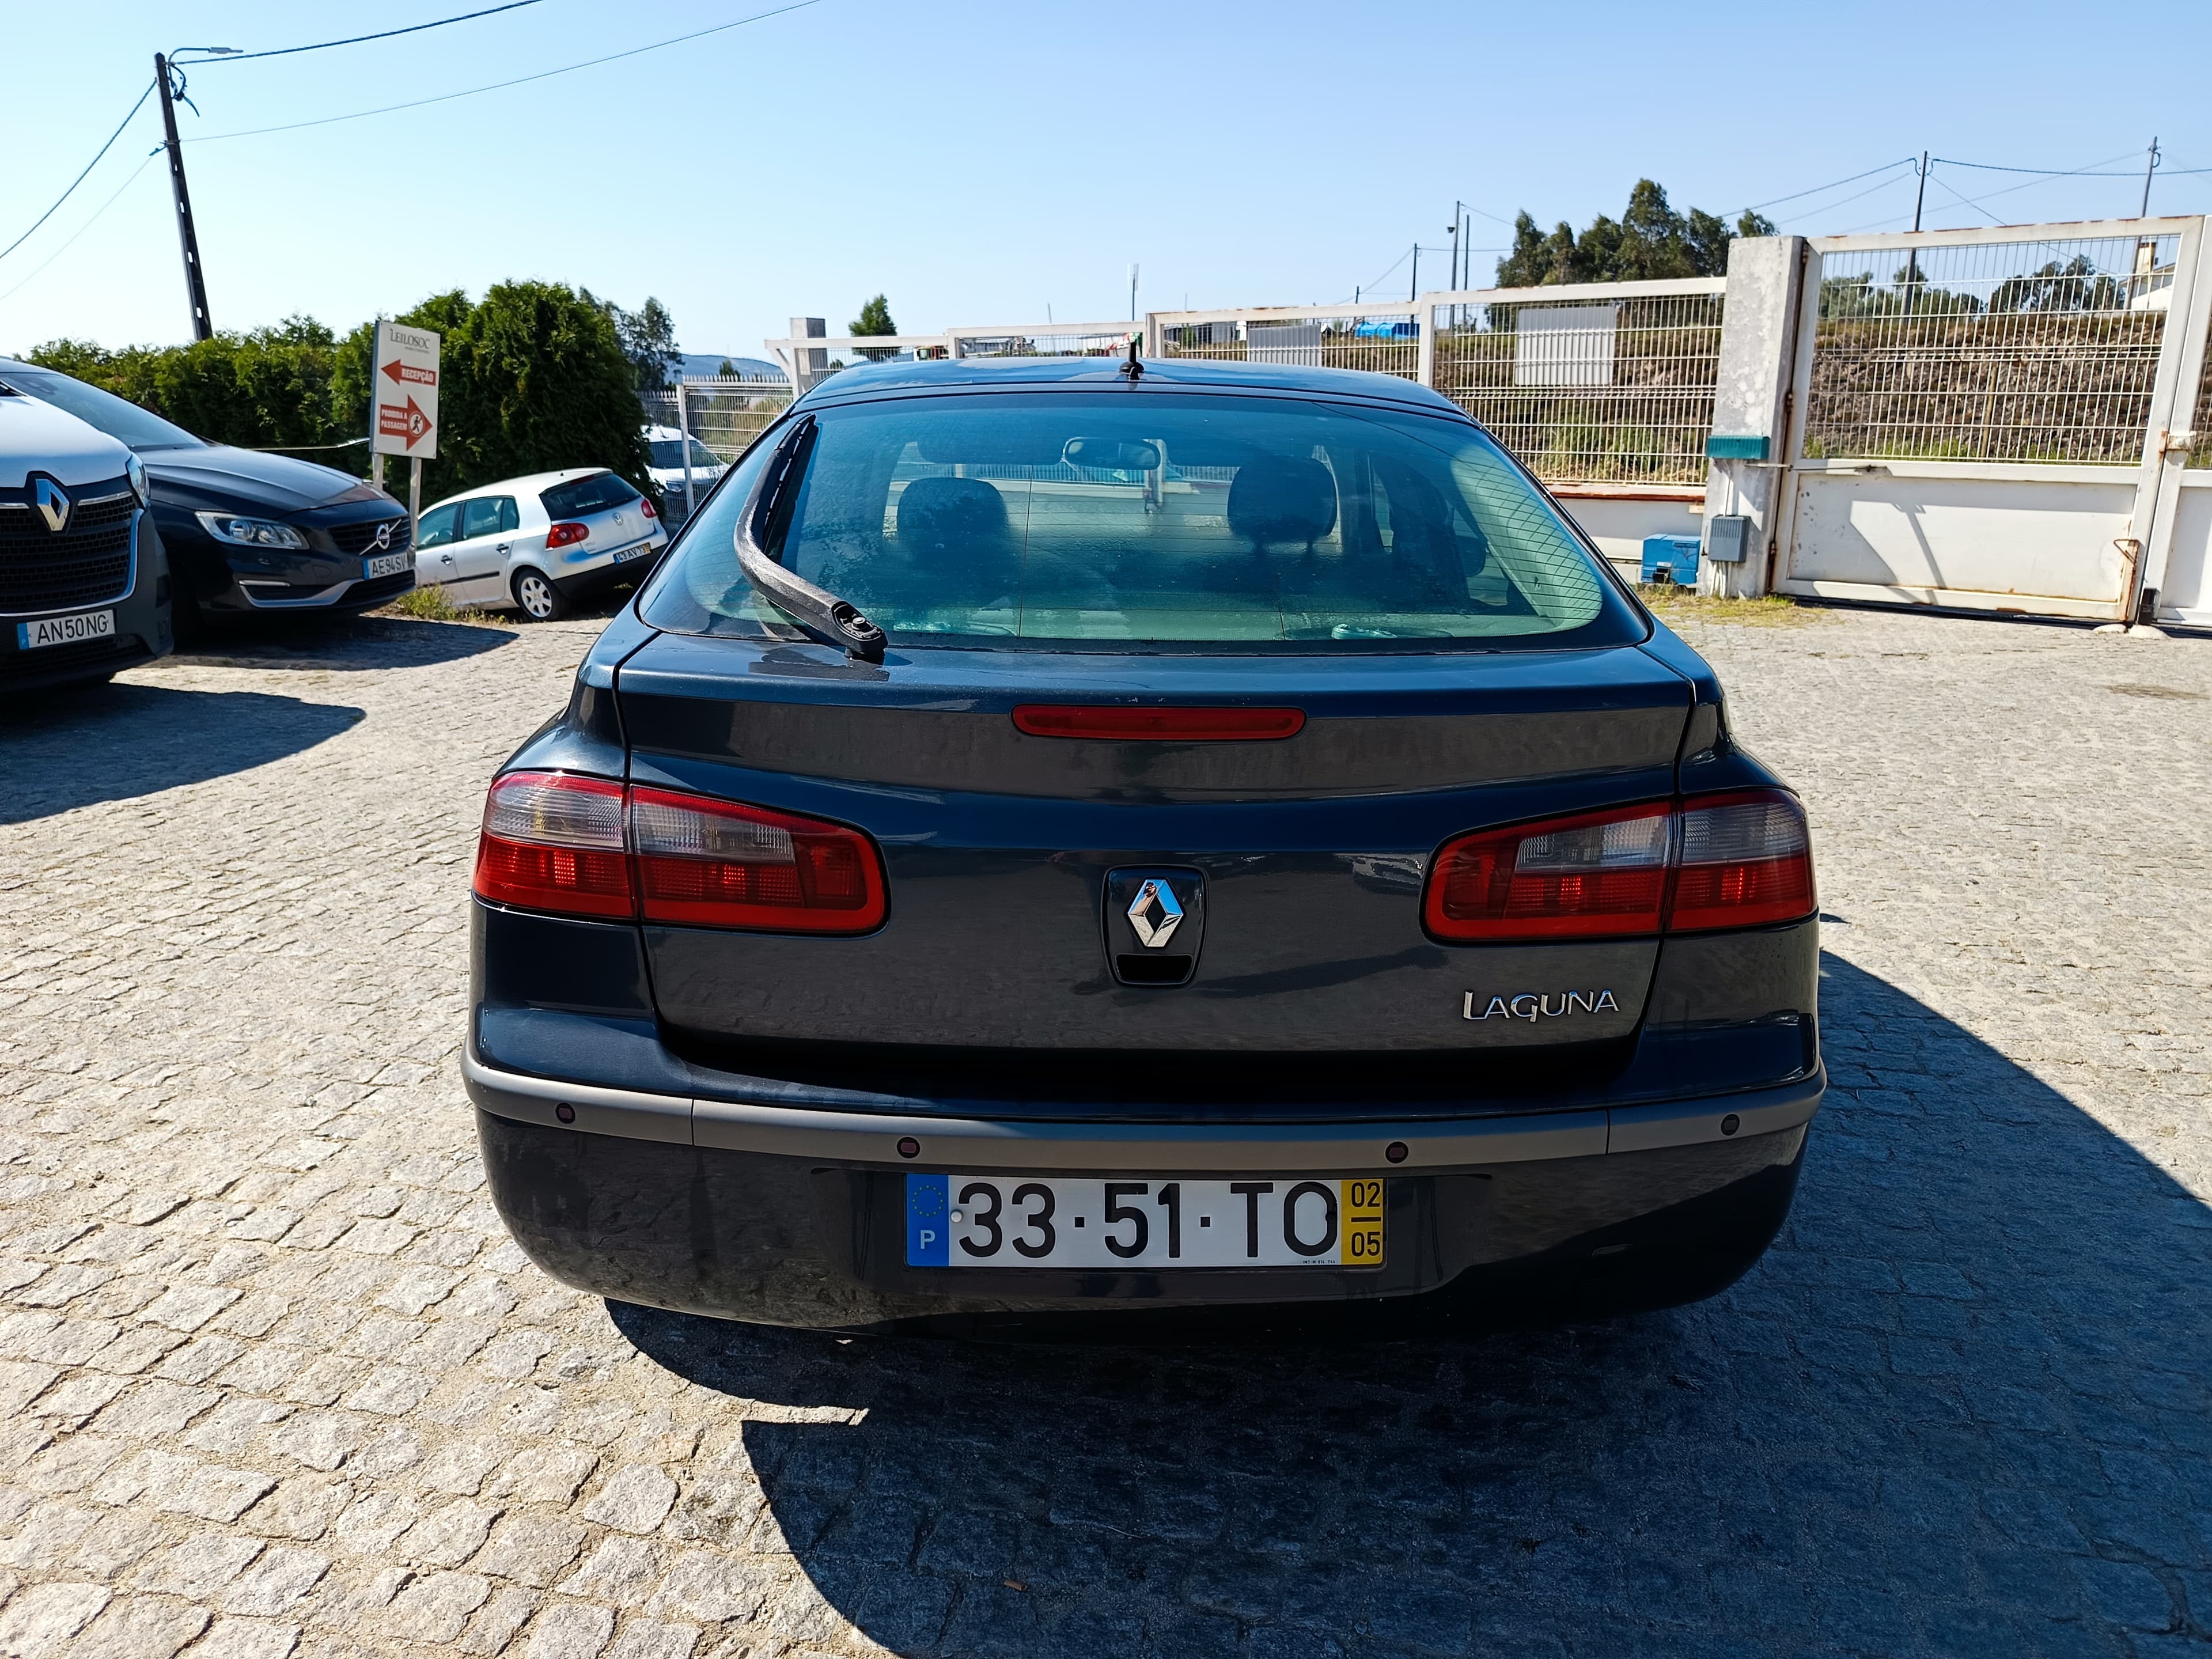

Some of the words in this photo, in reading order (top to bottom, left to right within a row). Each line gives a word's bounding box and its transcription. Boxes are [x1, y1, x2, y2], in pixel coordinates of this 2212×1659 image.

[402, 368, 434, 384] RECEPÇÃO
[381, 420, 408, 430] PASSAGEM
[1463, 988, 1620, 1022] LAGUNA
[1351, 1181, 1381, 1207] 02
[920, 1229, 936, 1249] P
[1351, 1230, 1381, 1257] 05
